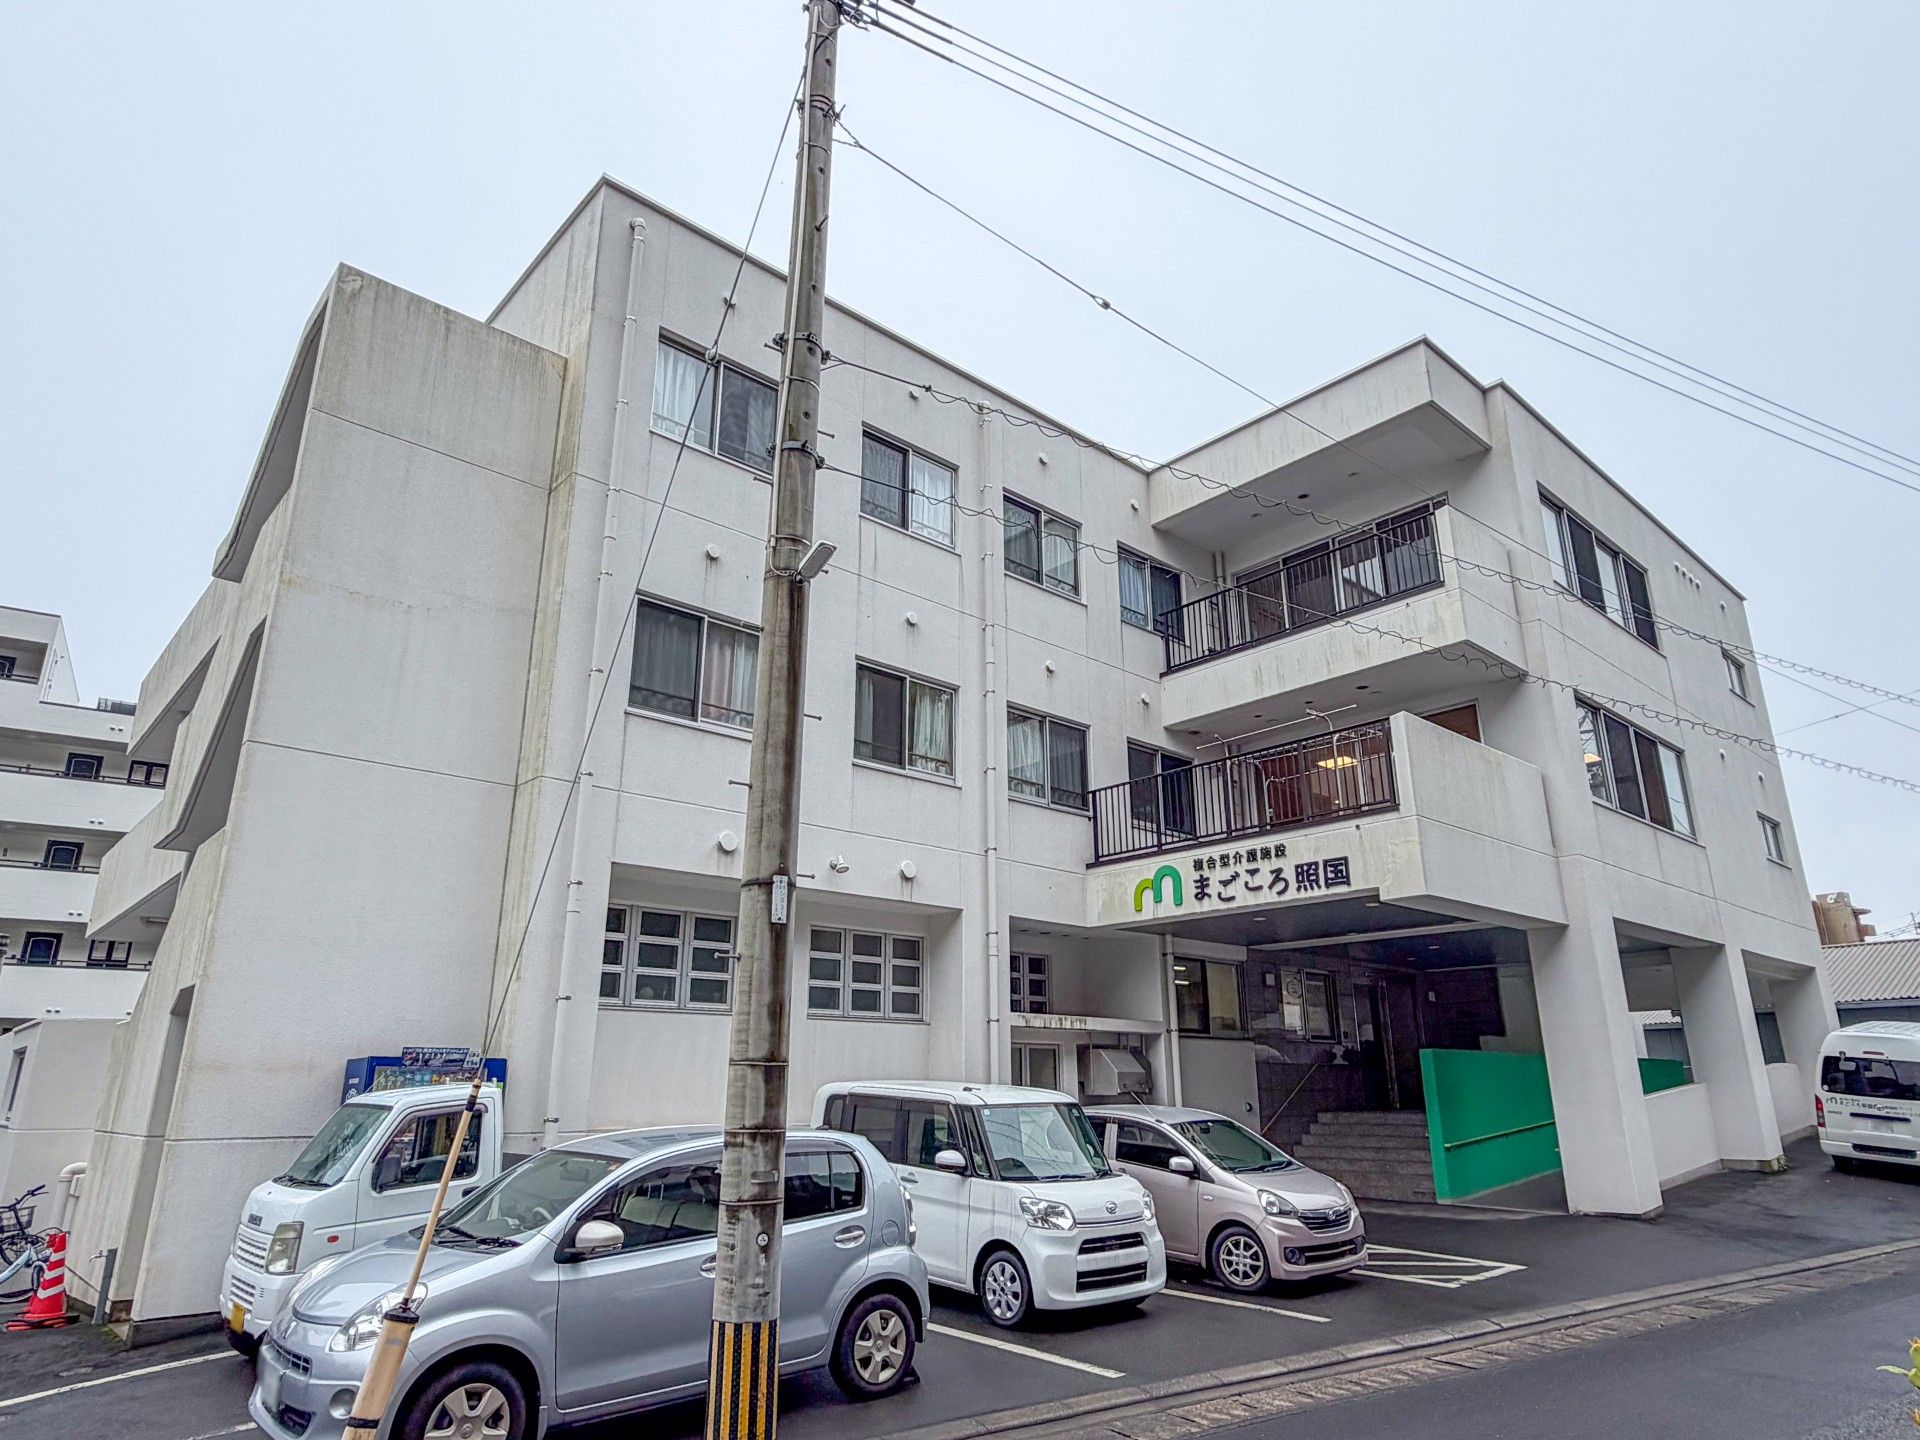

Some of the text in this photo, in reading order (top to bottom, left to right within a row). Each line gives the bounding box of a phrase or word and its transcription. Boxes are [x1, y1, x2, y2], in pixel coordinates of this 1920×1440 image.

[1192, 844, 1288, 872] 複合型介護施設
[1193, 856, 1352, 902] まごころ照国
